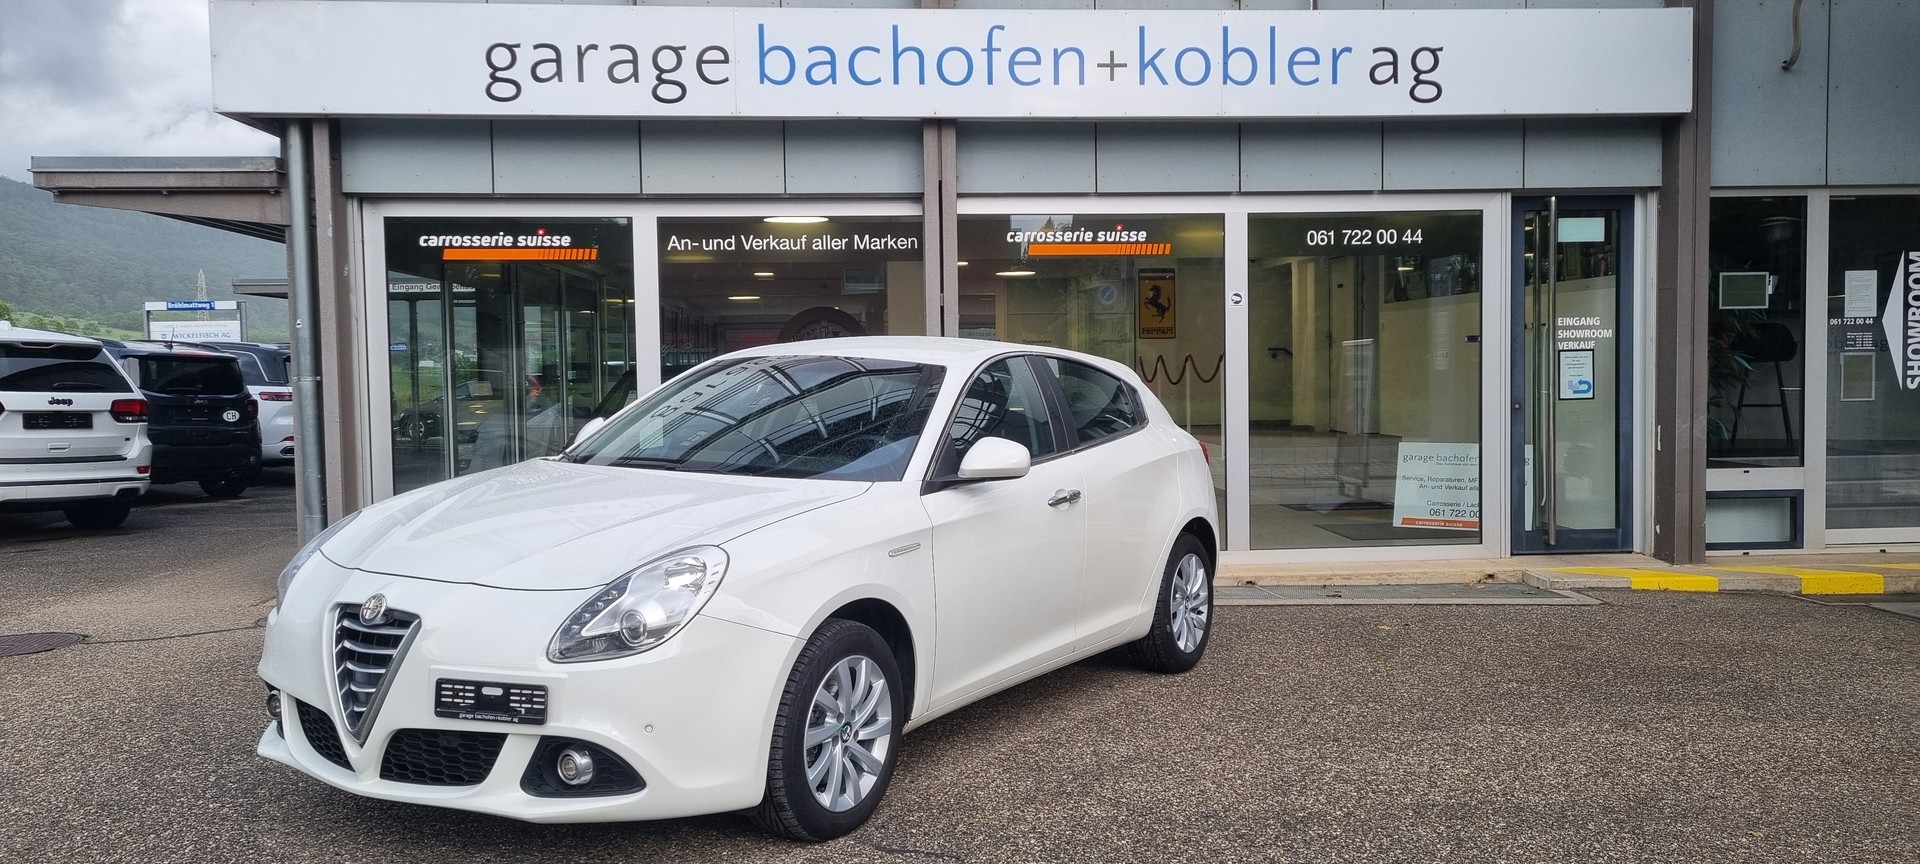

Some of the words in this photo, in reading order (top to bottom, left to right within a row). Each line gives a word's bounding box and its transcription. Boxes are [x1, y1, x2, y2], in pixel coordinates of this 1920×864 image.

[485, 42, 731, 104] garage
[757, 23, 1353, 87] bachofen+kobler
[1368, 45, 1444, 104] ag
[418, 231, 513, 247] carrosserie
[517, 229, 571, 247] suisse
[1006, 227, 1094, 243] carrosserie
[1096, 224, 1147, 243] suisse
[1306, 230, 1335, 245] 061
[1342, 229, 1372, 245] 722
[1376, 229, 1398, 244] 00
[1401, 228, 1424, 244] 44
[702, 234, 736, 251] und
[741, 234, 807, 250] Verkauf
[812, 234, 849, 250] aller
[854, 234, 918, 250] Marken
[391, 283, 424, 291] Eingang
[1557, 316, 1600, 326] EINGANG
[1829, 318, 1841, 326] 061
[1855, 317, 1864, 325] 00
[1865, 317, 1874, 325] 44
[1141, 327, 1174, 335] Ferrari
[1557, 329, 1613, 339] SHOWROOM
[1557, 340, 1596, 350] VERKAUF
[47, 396, 74, 407] Jeep
[226, 412, 237, 421] CH
[1402, 454, 1434, 464] garage
[1402, 475, 1426, 483] Service,
[1427, 476, 1467, 484] Reparaturen,
[1426, 500, 1462, 508] Carrosserie
[1429, 508, 1446, 517] 061
[1449, 509, 1467, 518] 722
[1445, 520, 1463, 528] suisse
